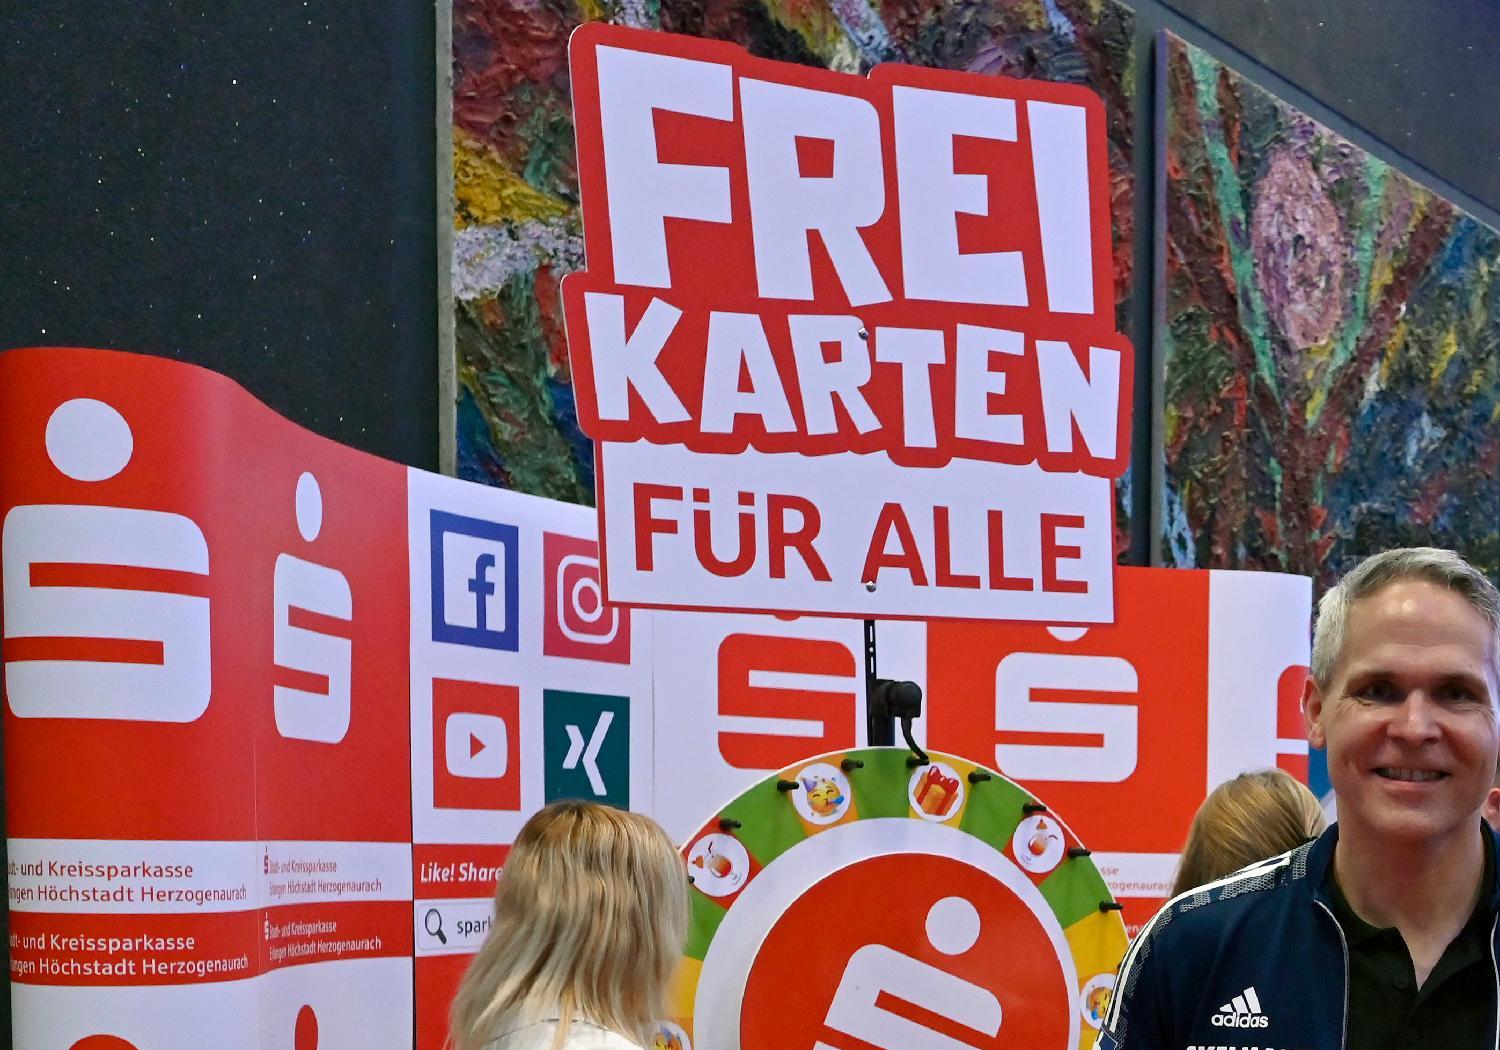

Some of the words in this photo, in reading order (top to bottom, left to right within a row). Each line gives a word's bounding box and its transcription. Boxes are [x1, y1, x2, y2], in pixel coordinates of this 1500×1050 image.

[596, 45, 1094, 314] FREI
[584, 292, 1121, 459] KARTEN
[633, 482, 832, 581] FÜR
[861, 502, 1088, 594] ALLE
[21, 861, 43, 877] und
[48, 861, 193, 880] Kreissparkasse
[291, 859, 337, 876] Kreissparkasse
[420, 863, 454, 883] Like!
[38, 886, 134, 902] Höchstadt
[141, 882, 247, 905] Herzogenaurach
[287, 881, 316, 895] Höchstadt
[318, 878, 382, 895] Herzogenaurach
[291, 920, 337, 938] Kreissparkasse
[23, 934, 45, 950] und
[50, 934, 195, 954] Kreissparkasse
[287, 942, 316, 957] Höchstadt
[317, 936, 382, 956] Herzogenaurach
[39, 958, 136, 975] Höchstadt
[142, 954, 248, 976] Herzogenaurach
[1211, 1011, 1269, 1029] adidas
